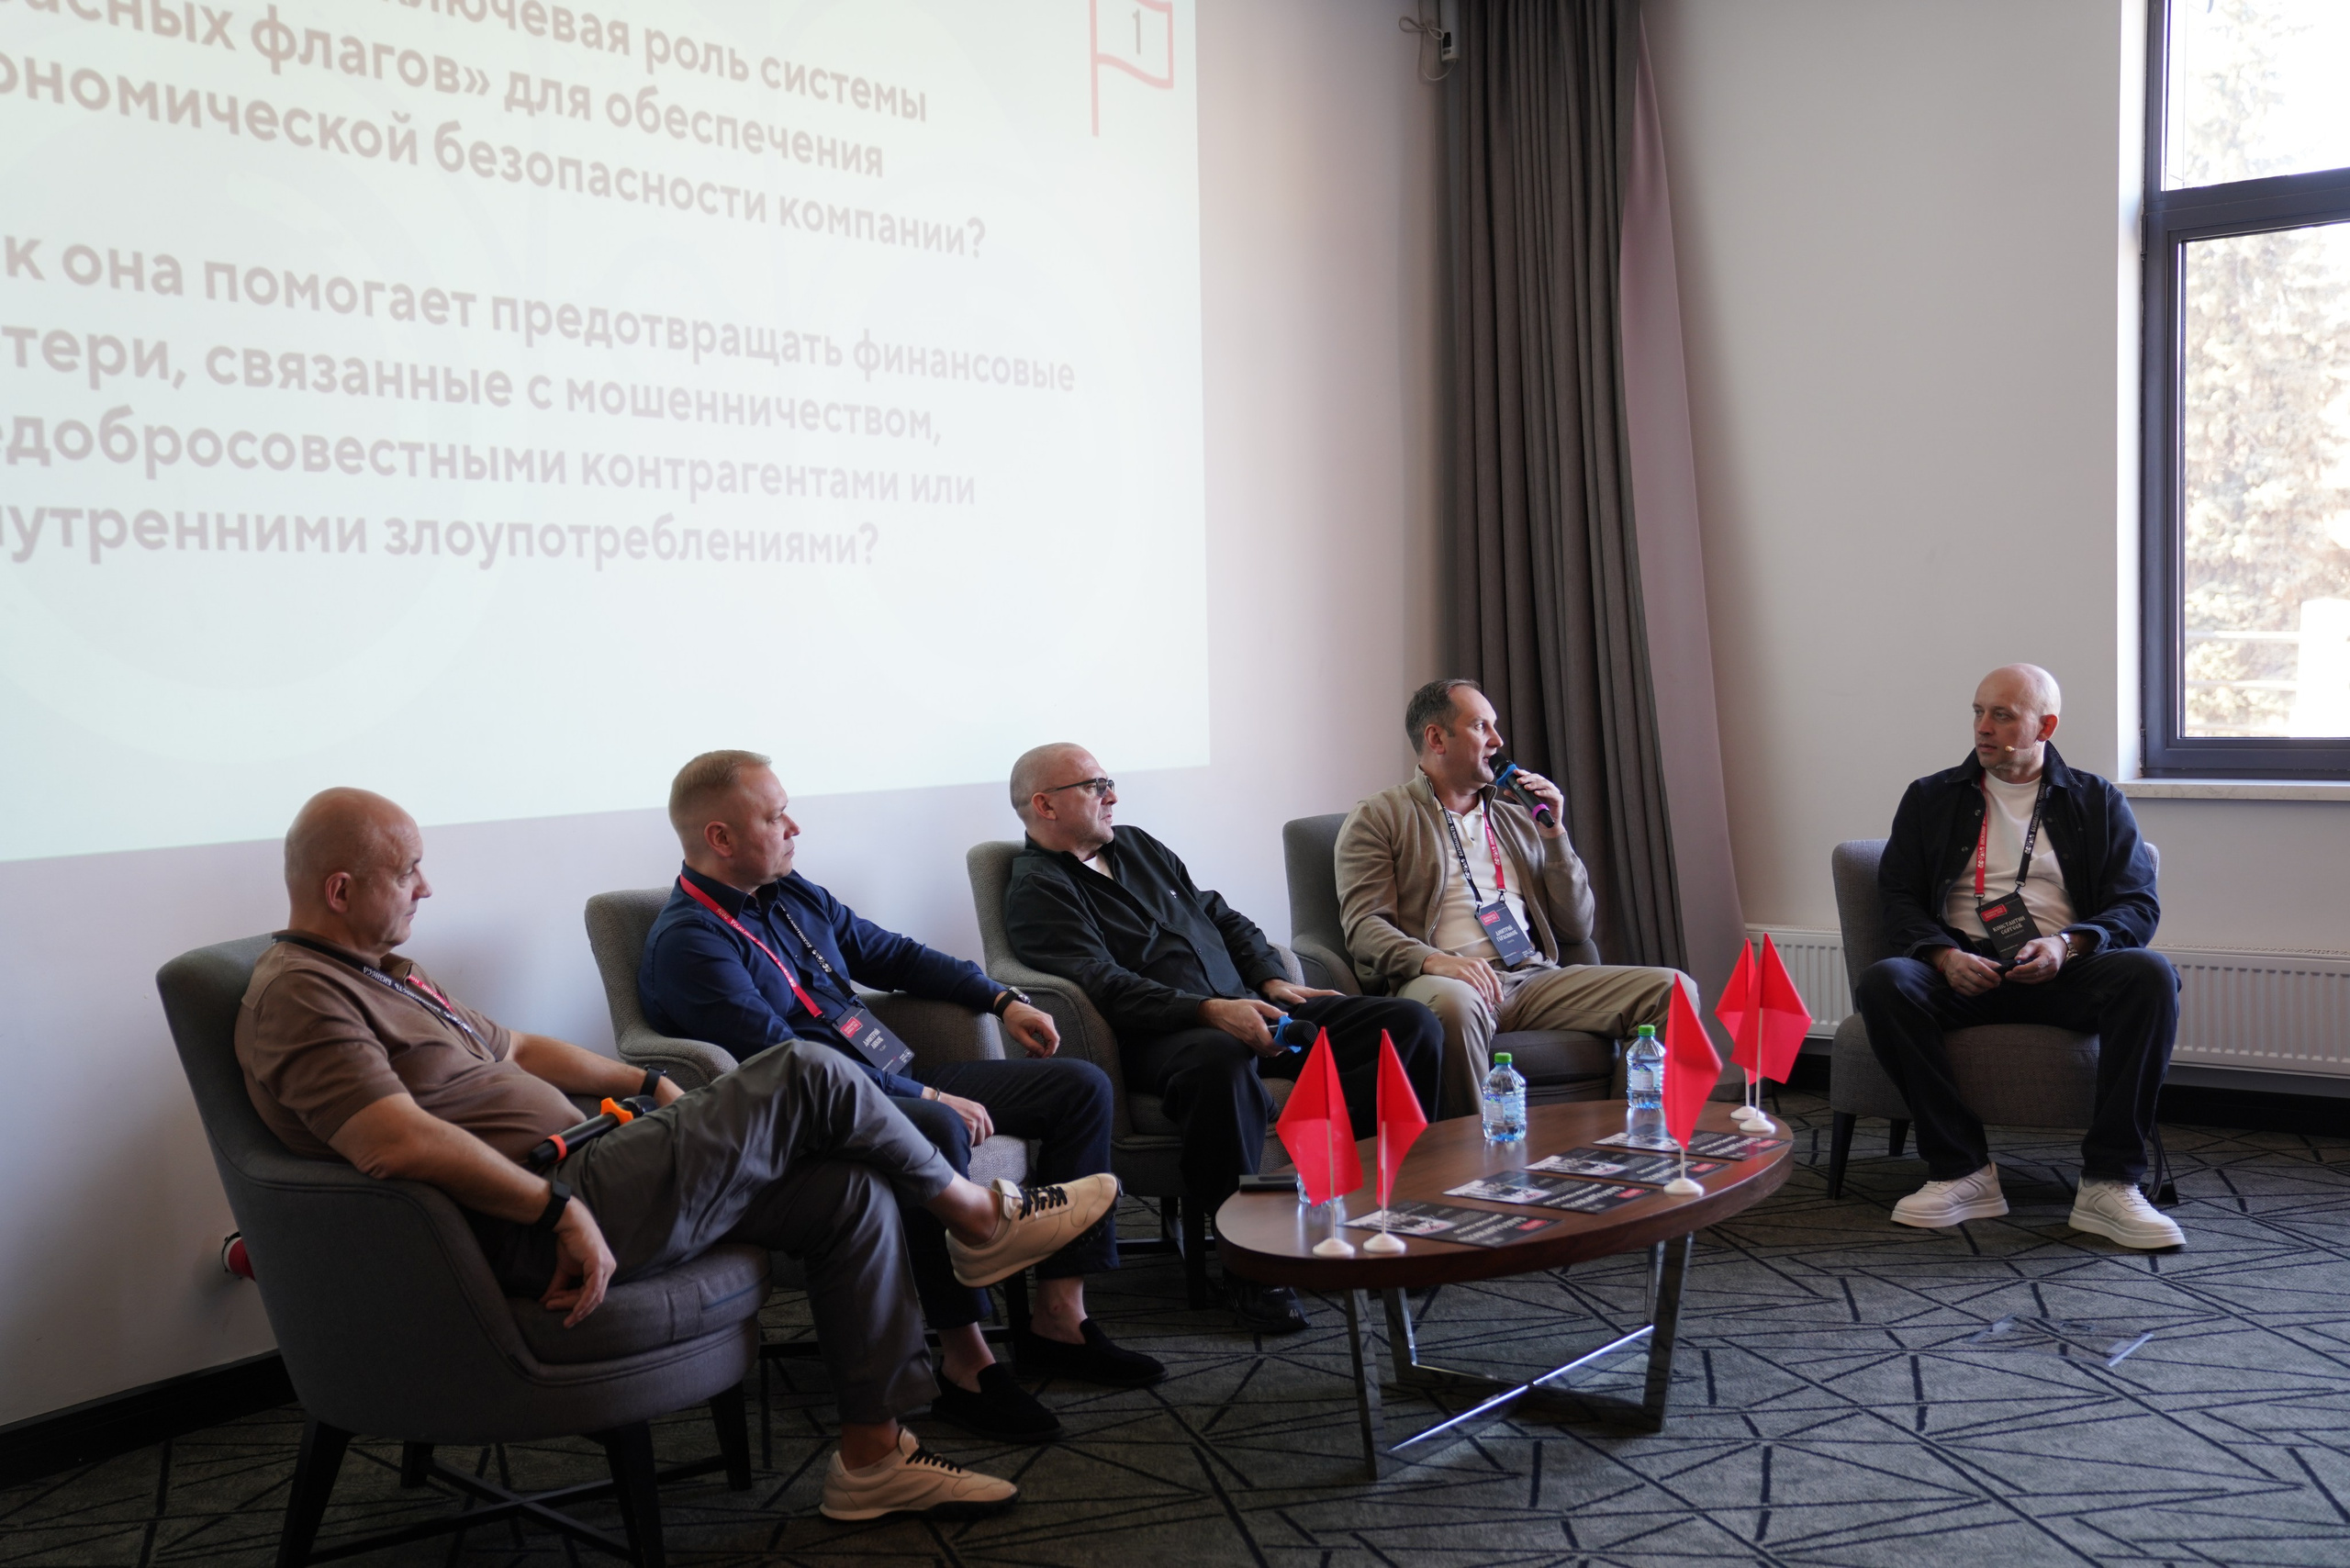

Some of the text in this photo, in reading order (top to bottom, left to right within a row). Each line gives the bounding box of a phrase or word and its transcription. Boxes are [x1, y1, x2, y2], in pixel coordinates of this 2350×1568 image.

[250, 5, 491, 96] флагов»
[503, 71, 592, 121] для
[604, 84, 883, 178] обеспечения
[382, 0, 926, 123] ючевая роль системы
[1131, 7, 1142, 55] 1
[433, 119, 767, 223] безопасности
[778, 195, 987, 259] компании?
[61, 242, 185, 297] она
[204, 260, 477, 328] помогает
[490, 296, 843, 367] предотвращать
[852, 328, 1076, 392] финансовые
[0, 325, 942, 447] тери, связанные с мошенничеством,
[0, 403, 975, 505] добросовестными контрагентами или
[0, 505, 879, 573] утренними злоупотреблениями?
